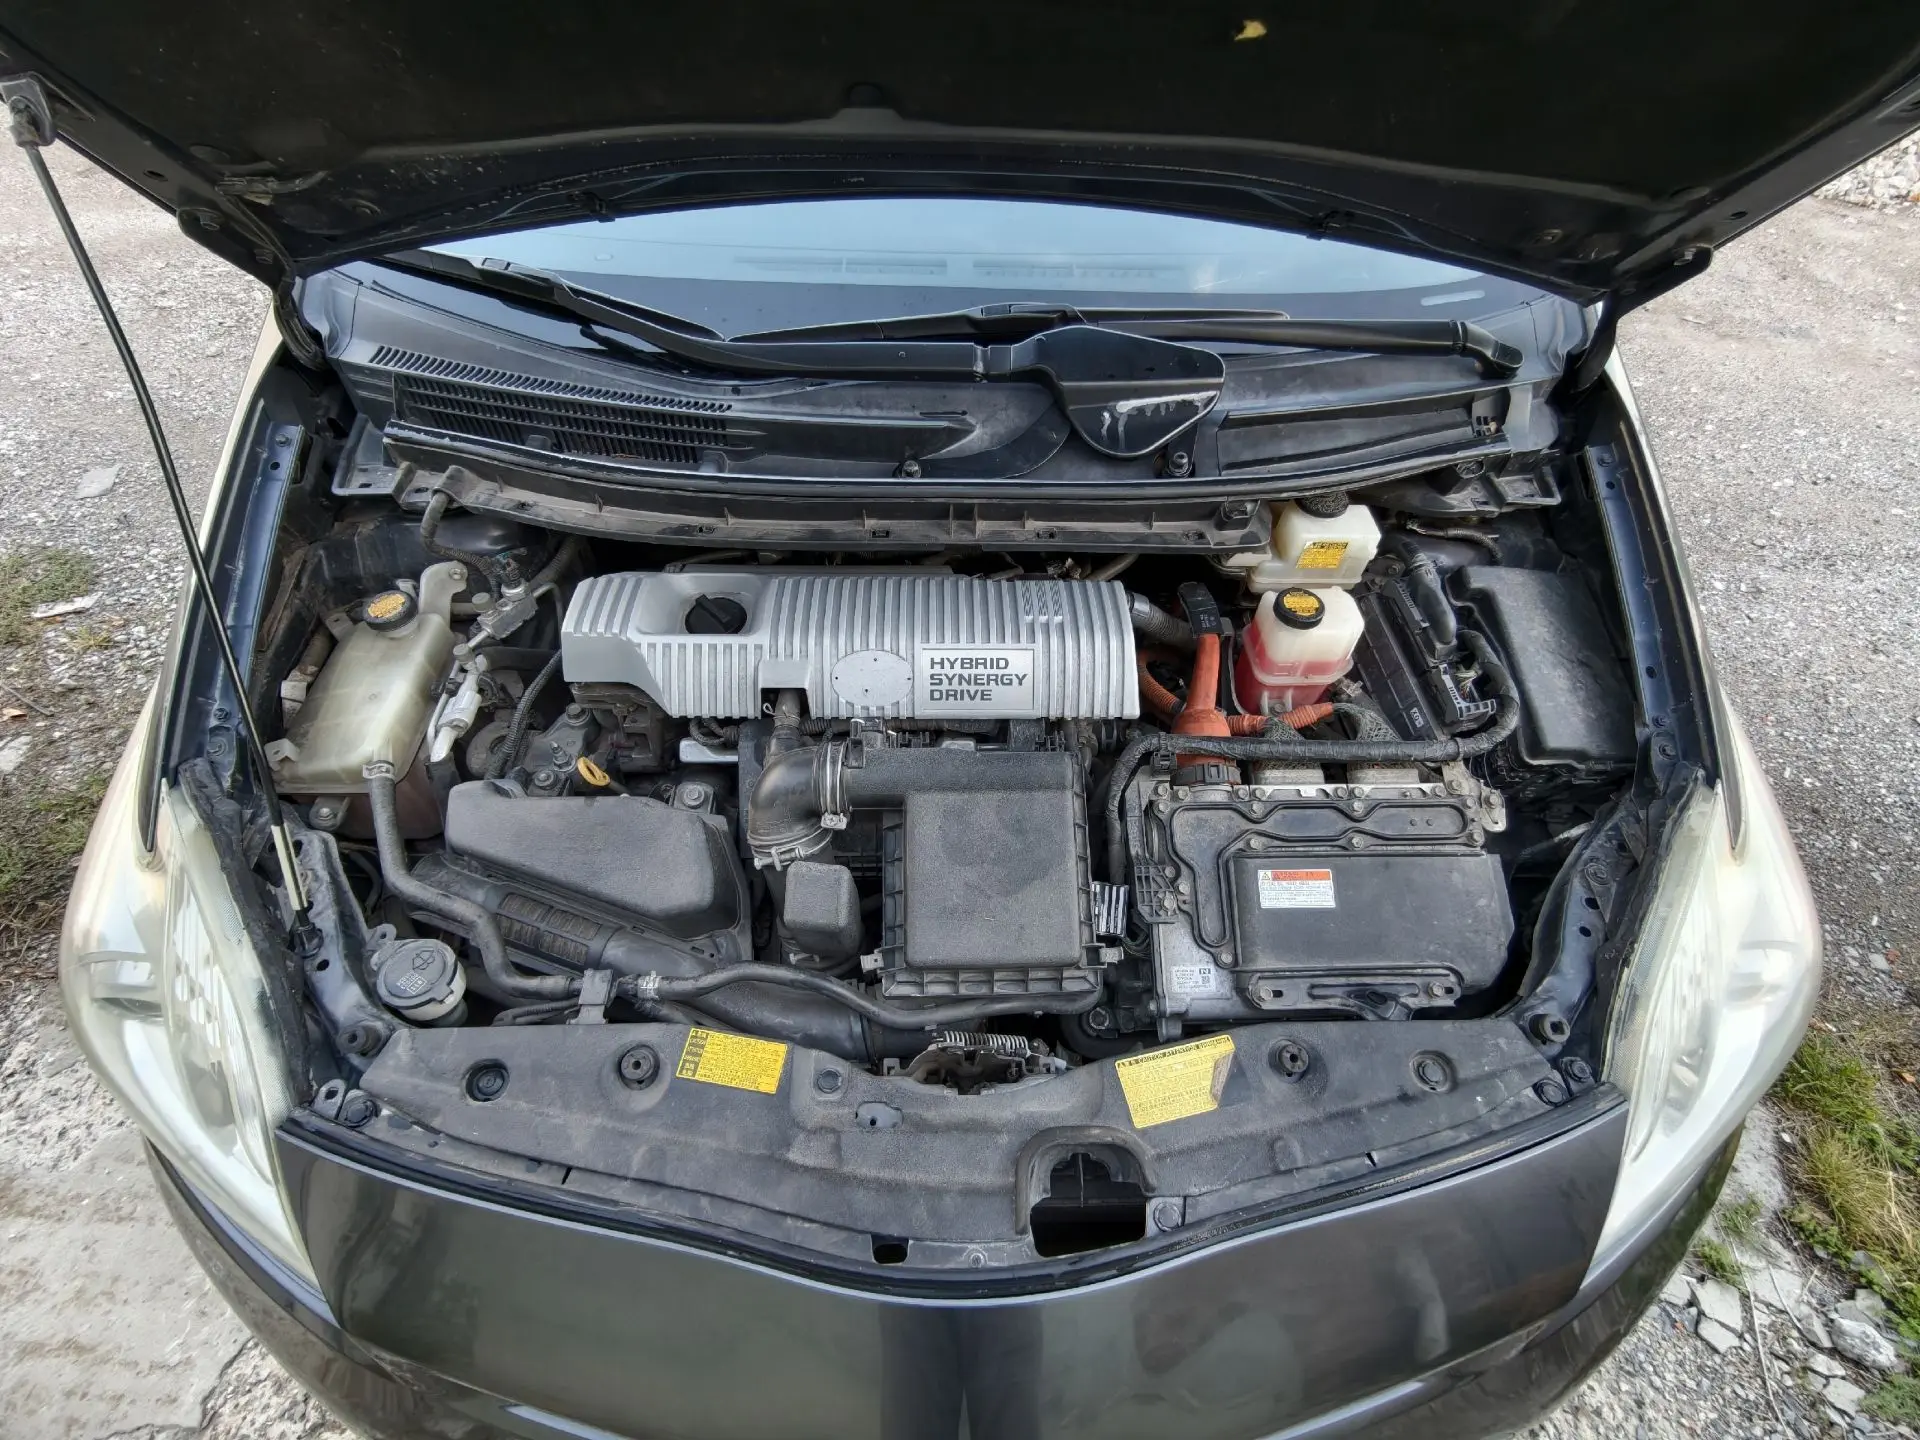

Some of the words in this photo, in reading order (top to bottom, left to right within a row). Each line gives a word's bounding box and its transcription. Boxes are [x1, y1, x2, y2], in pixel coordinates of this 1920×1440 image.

[930, 657, 1009, 669] HYBRID
[930, 673, 1028, 686] SYNERGY
[930, 689, 992, 701] DRIVE
